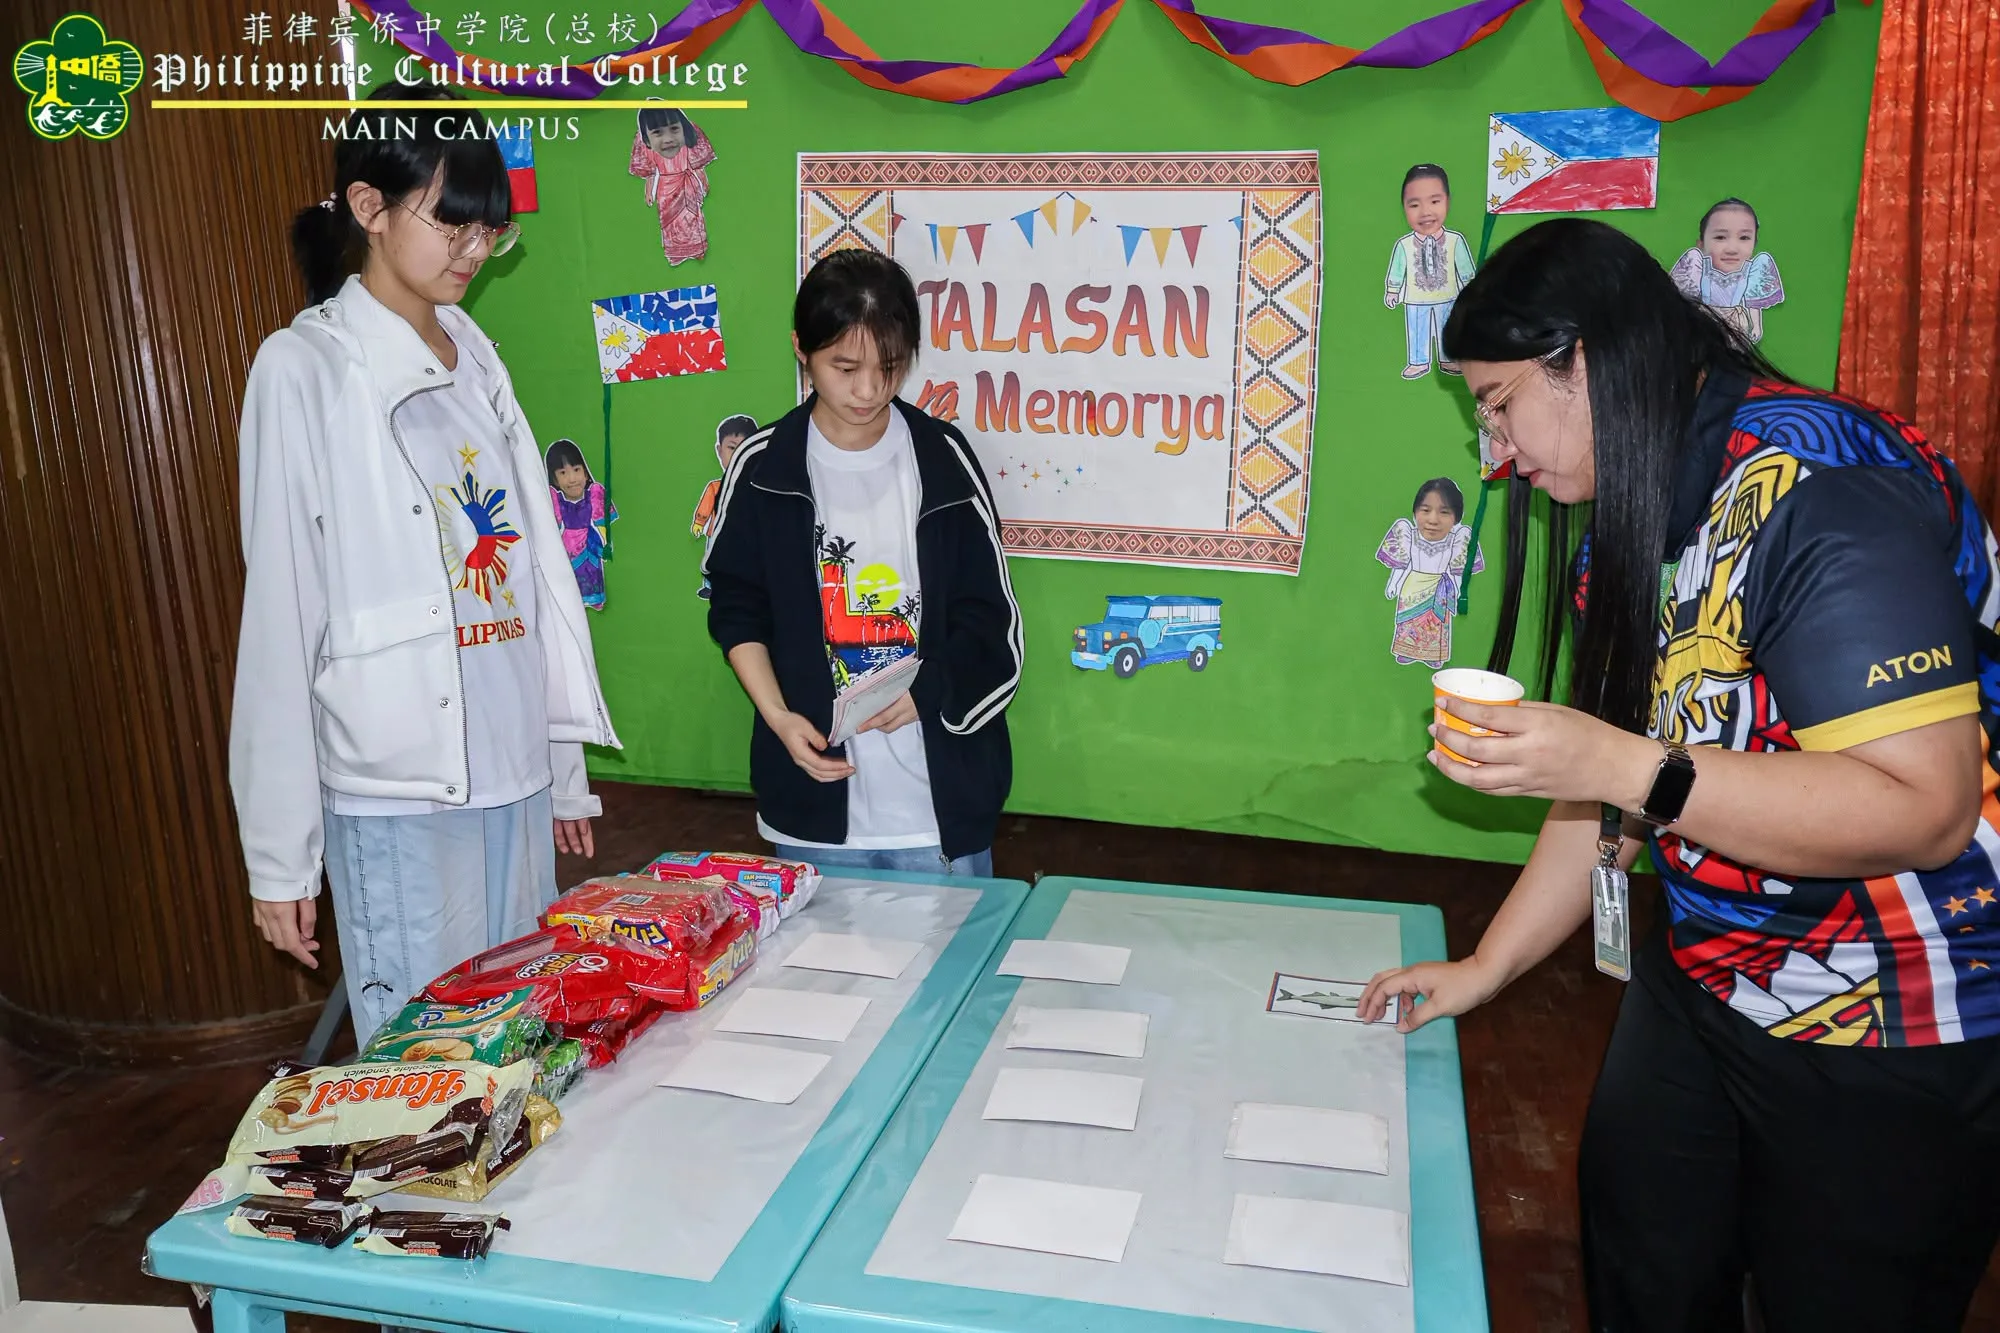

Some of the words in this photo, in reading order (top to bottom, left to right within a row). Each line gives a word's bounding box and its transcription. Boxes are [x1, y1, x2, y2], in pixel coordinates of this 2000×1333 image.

[974, 370, 1226, 456] Memorya
[456, 617, 526, 648] LIPINAS
[1866, 645, 1953, 689] ATON
[343, 1066, 391, 1078] Sandwich
[393, 1063, 446, 1074] Chocolate
[306, 1069, 467, 1117] Hansel
[418, 1176, 458, 1189] OCOLATE
